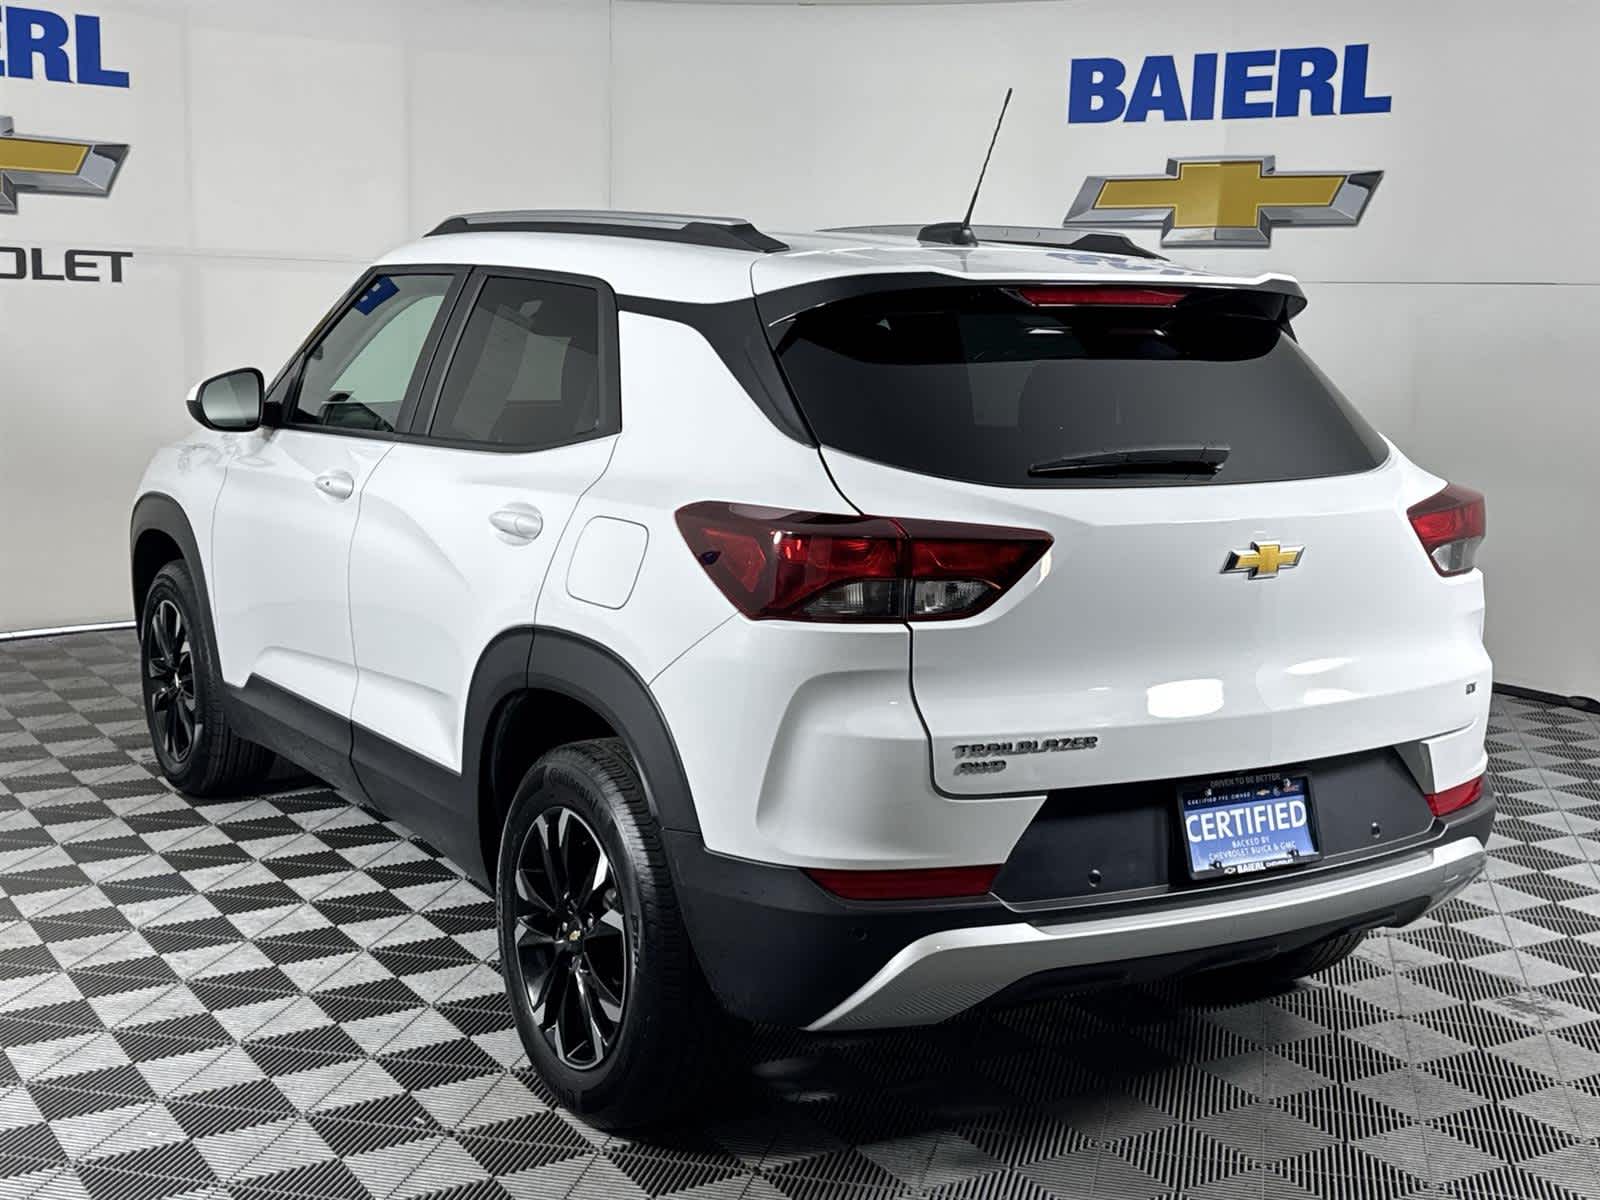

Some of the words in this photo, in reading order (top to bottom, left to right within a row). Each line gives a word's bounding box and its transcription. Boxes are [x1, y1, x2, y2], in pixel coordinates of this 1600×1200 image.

[1068, 43, 1393, 124] BAIERL
[952, 736, 1098, 760] TRAILBLAZER
[953, 760, 1007, 776] AWD
[1185, 800, 1307, 843] CERTIFIED
[1208, 848, 1250, 861] CHEVROLET
[1250, 844, 1272, 856] BUICK
[1272, 843, 1279, 852] &
[1280, 840, 1297, 850] GMC
[1231, 837, 1260, 849] BACKED
[1260, 835, 1270, 845] BY
[1237, 861, 1266, 874] BAIERL
